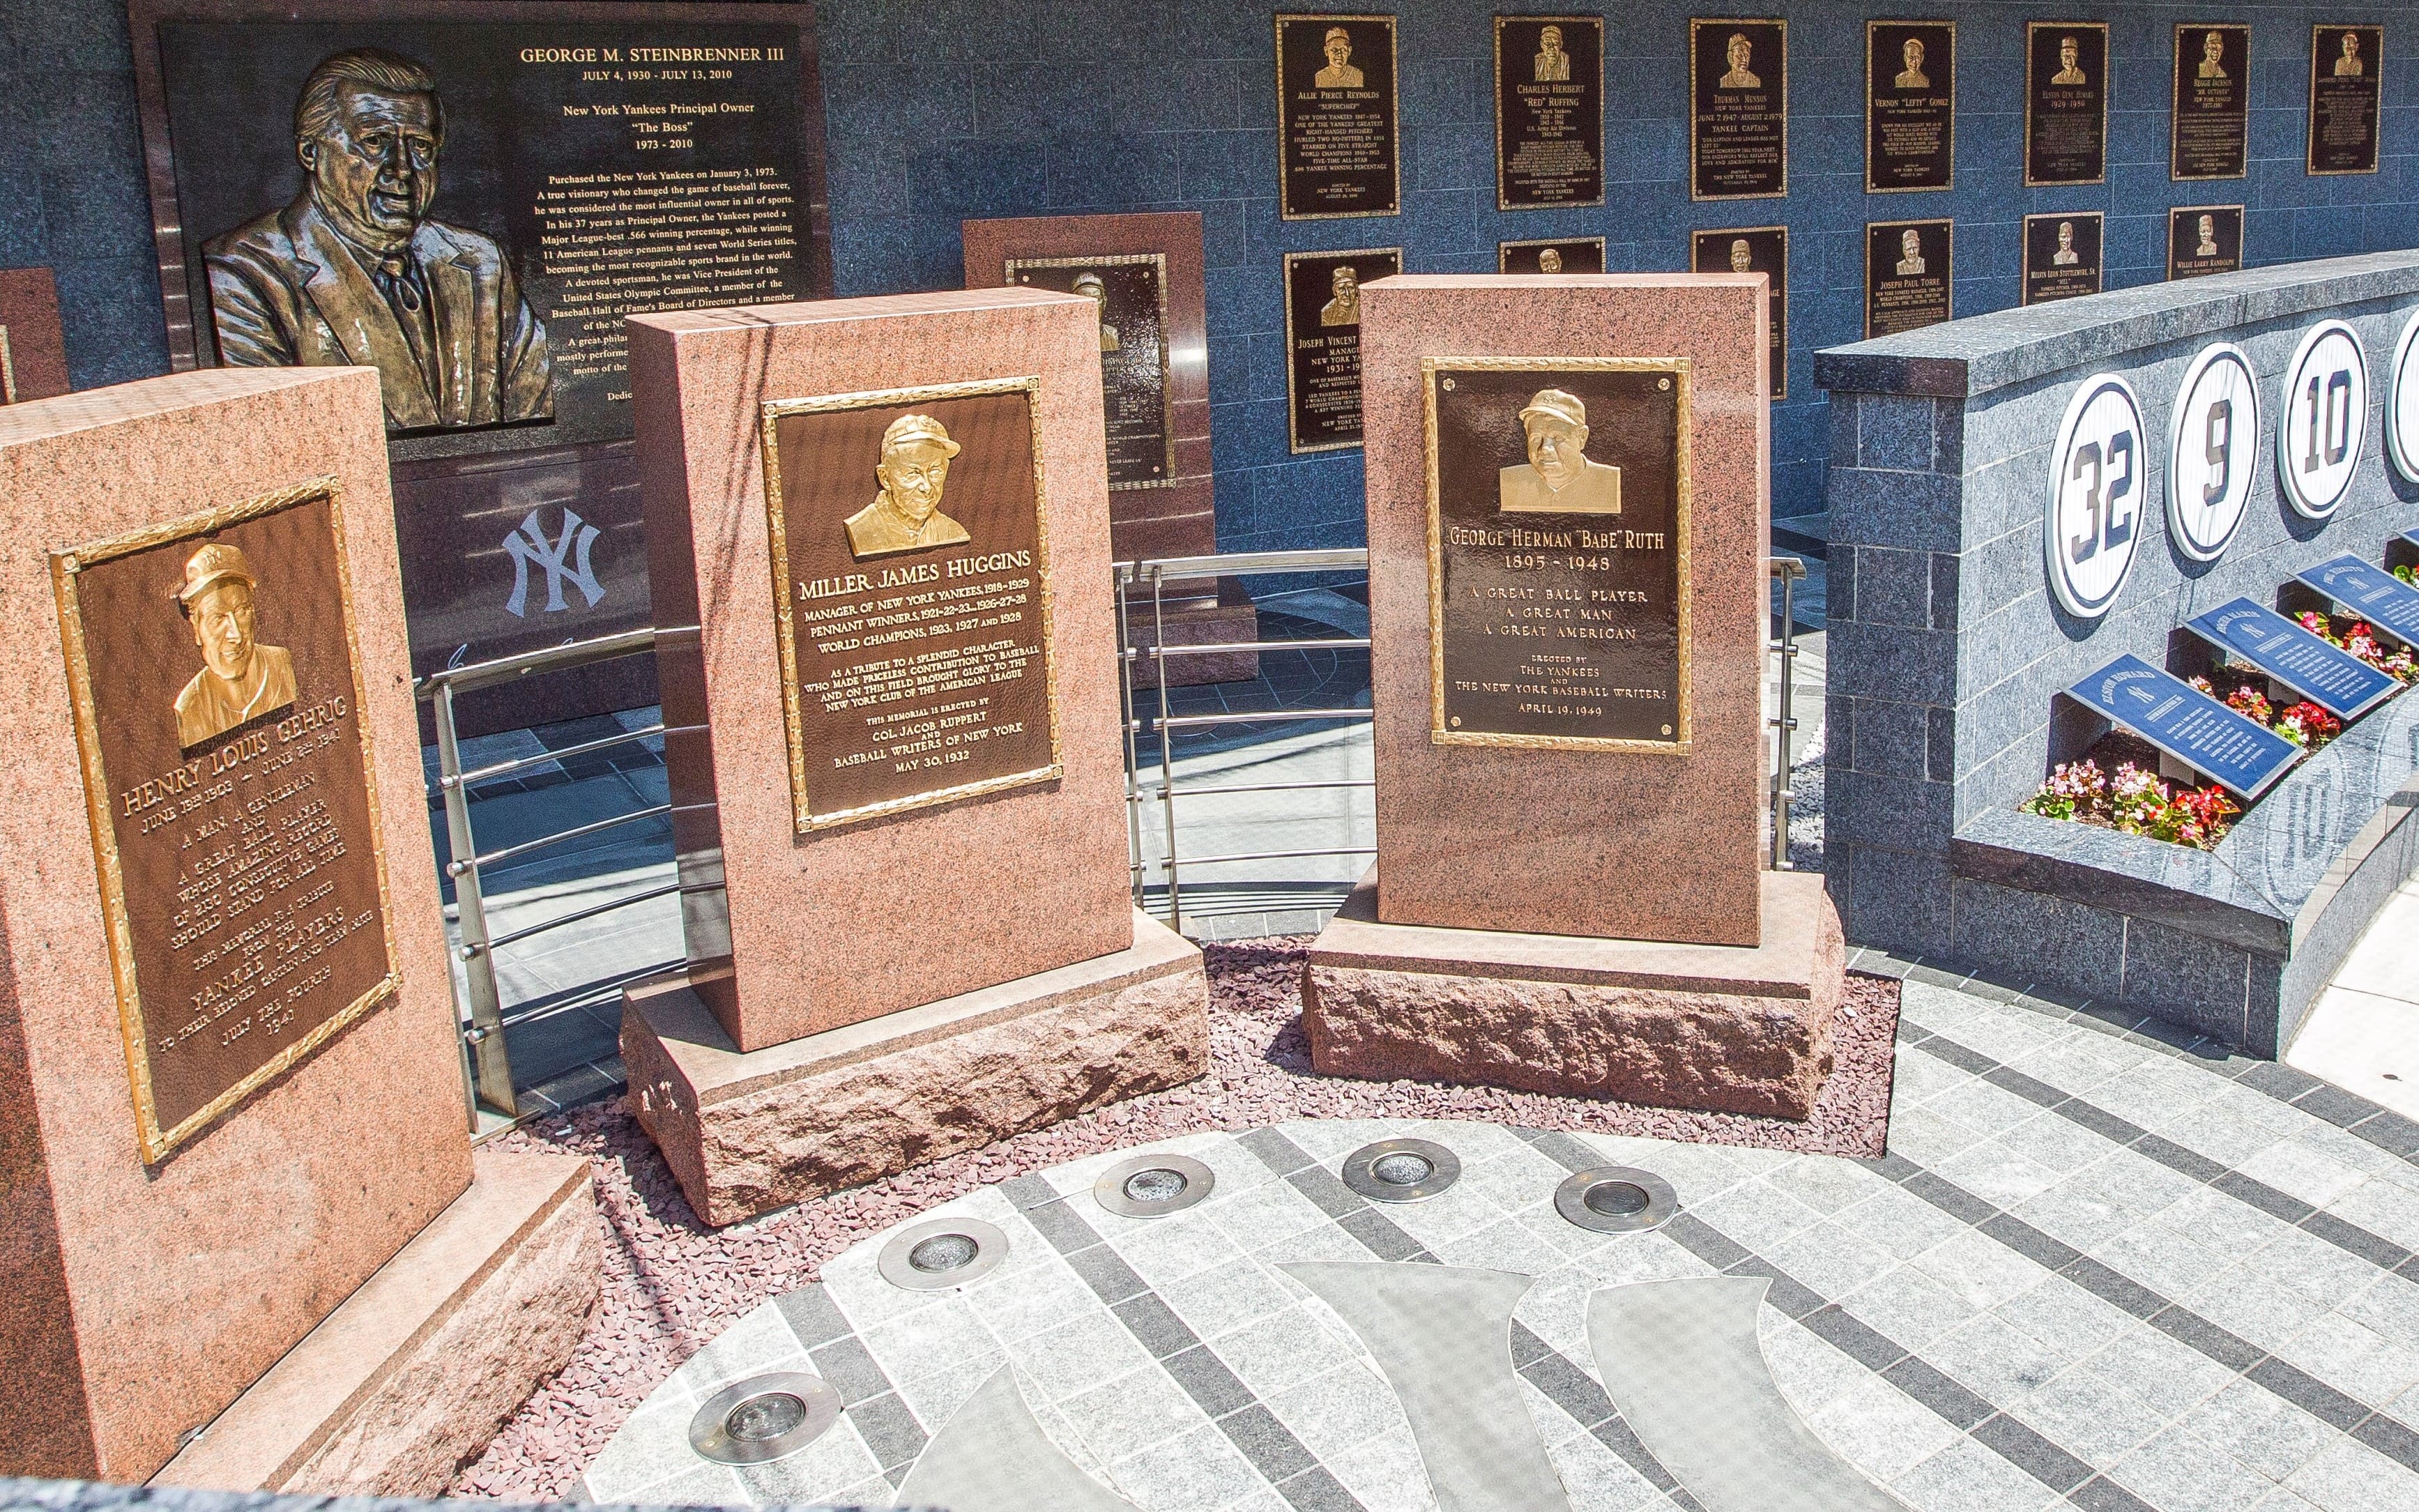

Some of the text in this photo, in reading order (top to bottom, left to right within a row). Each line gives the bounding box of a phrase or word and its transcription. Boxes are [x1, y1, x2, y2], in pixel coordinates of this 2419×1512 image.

[520, 48, 783, 62] GEORGE M. STEINBRENNER III
[582, 71, 609, 80] JULY
[613, 70, 623, 81] 4,
[627, 70, 650, 79] 1930
[661, 70, 687, 79] JULY
[692, 70, 705, 79] 13,
[709, 70, 731, 78] 2010
[1298, 91, 1317, 100] ALLIE
[1517, 84, 1585, 93] CHARLES HERBERT
[563, 102, 754, 116] New York Yankees Principal Owner
[1549, 98, 1579, 106] RUFFING
[1875, 98, 1898, 107] VERNON
[632, 121, 692, 132] "The Boss"
[636, 139, 658, 149] 1973
[669, 139, 692, 148] 2010
[549, 174, 594, 184] Purchased
[597, 174, 610, 182] the
[613, 173, 633, 181] New
[636, 171, 657, 180] York
[659, 171, 694, 179] Yankees
[710, 169, 741, 178] January
[744, 168, 751, 176] 3,
[755, 167, 777, 176] 1973.
[537, 191, 544, 199] A
[567, 189, 609, 199] visionary
[611, 188, 630, 196] who
[633, 185, 668, 197] changed
[687, 186, 708, 194] game
[711, 183, 721, 192] of
[723, 182, 756, 191] baseball
[534, 206, 545, 214] he
[568, 202, 616, 213] considered
[618, 202, 632, 211] the
[658, 199, 701, 208] influential
[743, 196, 754, 204] all
[756, 196, 765, 204] of
[768, 196, 793, 205] sports.
[1880, 278, 1941, 290] JOSEPH PAUL TORRE
[1298, 336, 1357, 349] JOSEPH VINCENT
[2304, 369, 2351, 474] 10
[2203, 399, 2232, 507] 9
[2071, 429, 2133, 565] 32
[1450, 526, 1505, 546] GEORGE
[1512, 528, 1571, 548] HERMAN
[1625, 530, 1664, 549] RUTH
[502, 507, 606, 618] NY
[1505, 555, 1545, 570] 1895
[1568, 556, 1609, 571] 1948
[800, 549, 1031, 600] MILLER JAMES HUGGINS
[804, 578, 1030, 622] MANAGER OF NEW YORK YANKEES, 1918-1929
[1470, 587, 1647, 602] A GREAT BALL PLAYER
[1506, 607, 1611, 620] A GREAT MAN
[818, 611, 1021, 653] WORLD CHAMPIONS, 1923, 1927 AND 1928
[1483, 623, 1635, 639] A GREAT AMERICAN
[1520, 665, 1598, 677] THE YANKEES
[1455, 680, 1665, 699] THE NEW YORK BASEBALL WRITERS
[1518, 703, 1552, 713] APRIL
[1576, 706, 1601, 716] 1949
[872, 710, 986, 741] COL. JACOB RUPPERT
[121, 696, 347, 817] HENRY LOUIS GEHRIG
[895, 749, 969, 772] MAY 30, 1932
[178, 799, 328, 885] A GREAT BALL PLAYER
[190, 906, 344, 1011] YANKEE PLAYERS
